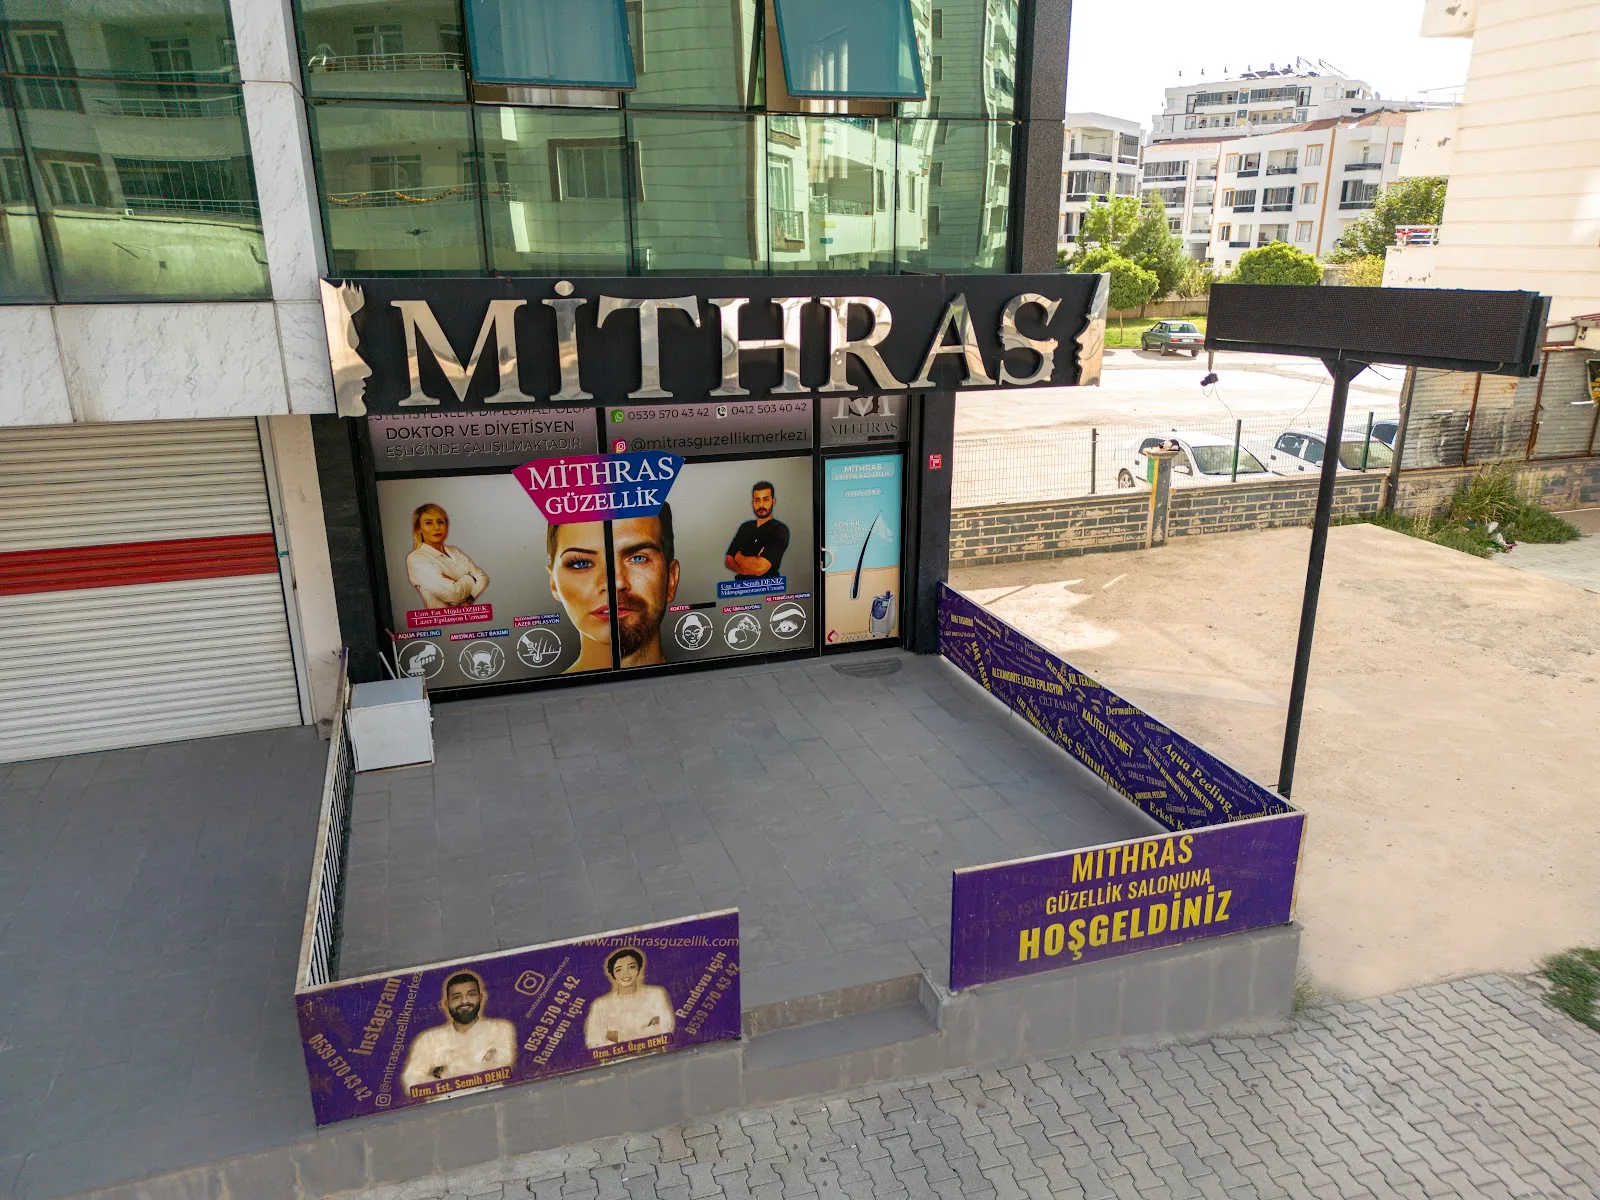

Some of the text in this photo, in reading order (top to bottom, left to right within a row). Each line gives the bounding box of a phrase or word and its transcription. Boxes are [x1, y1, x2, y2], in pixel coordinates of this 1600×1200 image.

[390, 280, 1064, 403] MİTHRAS
[627, 407, 710, 420] 0539 570 43 42
[731, 402, 807, 415] 0412 503 40 42
[386, 419, 575, 440] DOKTOR VE DİYETİSYEN
[631, 430, 808, 451] @mitrasguzellikmerkezi
[386, 437, 582, 460] EŞLİĞİNDE ÇALIŞILMAKTADIR
[526, 456, 675, 491] MİTHRAS
[545, 486, 661, 515] GÜZELLİK
[415, 617, 433, 626] Lazer
[433, 614, 464, 626] Epilasyon
[489, 629, 509, 638] BAKIMI
[398, 631, 415, 640] AQUA
[971, 640, 982, 661] KAŞ
[1020, 675, 1037, 689] LAZER
[1054, 698, 1079, 713] BAKIMI
[1057, 724, 1073, 750] Saç
[1082, 708, 1134, 758] KALİTELİ HİZMET
[1131, 721, 1171, 768] Akne Tedavisi
[1163, 742, 1234, 814] Aqua Peeling
[1175, 770, 1215, 813] AKUPUNKTUR
[1149, 800, 1175, 827] Erkek
[1268, 803, 1285, 817] Cilt
[1045, 868, 1212, 916] GÜZELLİK SALONUNA
[1018, 885, 1233, 962] HOŞGELDİNİZ
[572, 935, 740, 950] www.mithrasguzellik.com
[675, 951, 727, 1019] Randevu için
[685, 962, 740, 1036] 0539 570 43 42
[347, 977, 402, 1056] İnstagram
[523, 975, 581, 1052] 0539 570 43 42
[533, 996, 586, 1066] Randevu için
[592, 1035, 669, 1060] Uzm. Est. Özge DENİZ
[308, 1033, 374, 1103] 0539 570 43 42
[410, 1067, 511, 1099] Uzm. Est. Semih DENİZ
